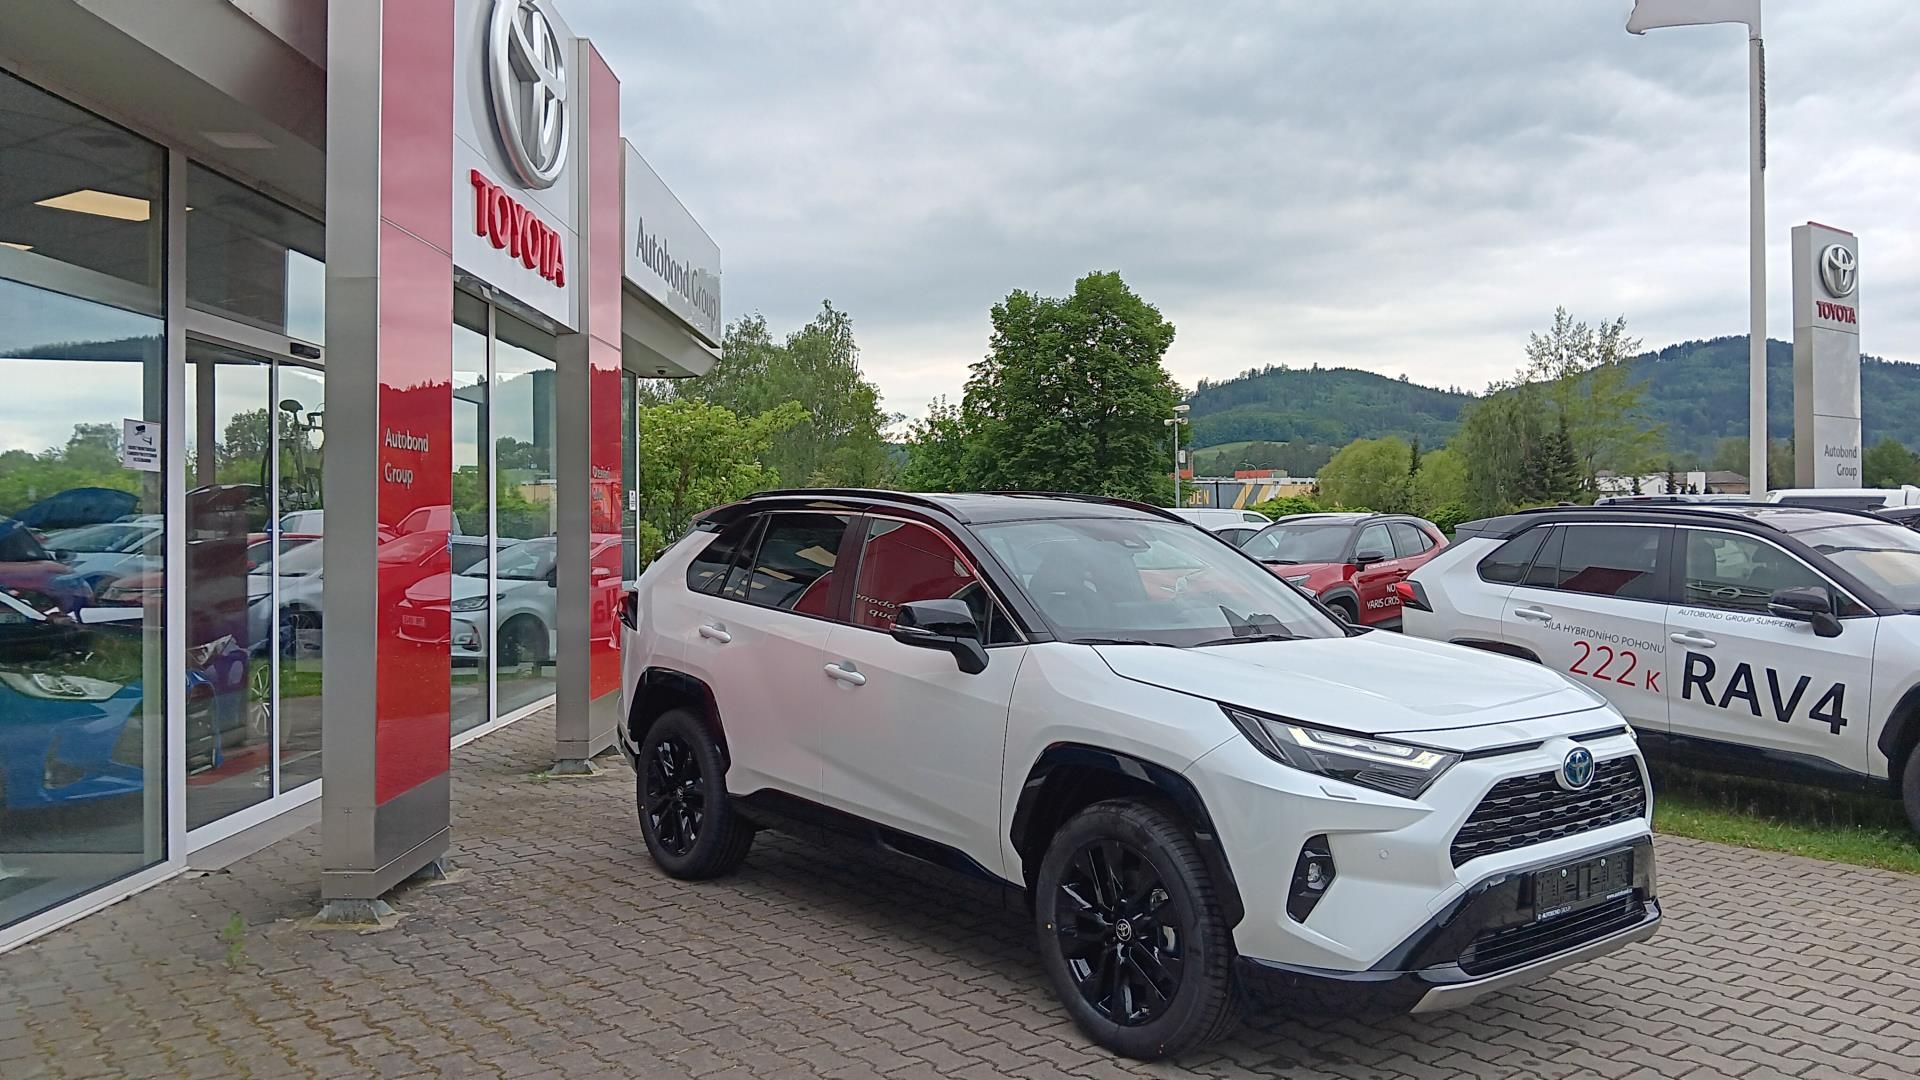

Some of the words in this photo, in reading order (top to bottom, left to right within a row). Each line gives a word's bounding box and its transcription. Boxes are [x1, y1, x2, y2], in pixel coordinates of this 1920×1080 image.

[471, 168, 565, 288] TOYOTA
[636, 215, 689, 299] Autobond
[692, 268, 717, 332] Group
[1816, 300, 1857, 324] TOYOTA
[385, 427, 429, 452] Autobond
[1824, 444, 1857, 459] Autobond
[384, 462, 414, 490] Group
[1836, 463, 1857, 481] Group
[1386, 583, 1397, 593] NO
[1366, 598, 1384, 610] YARIS
[1384, 596, 1400, 607] CROS
[1678, 608, 1723, 620] AUTOBOND
[1725, 613, 1756, 624] GROUP
[1563, 624, 1619, 643] HYBRIDNÍHO
[1620, 636, 1665, 654] POHONU
[1569, 640, 1637, 687] 222
[1645, 669, 1661, 693] K
[1681, 650, 1848, 736] RAV4
